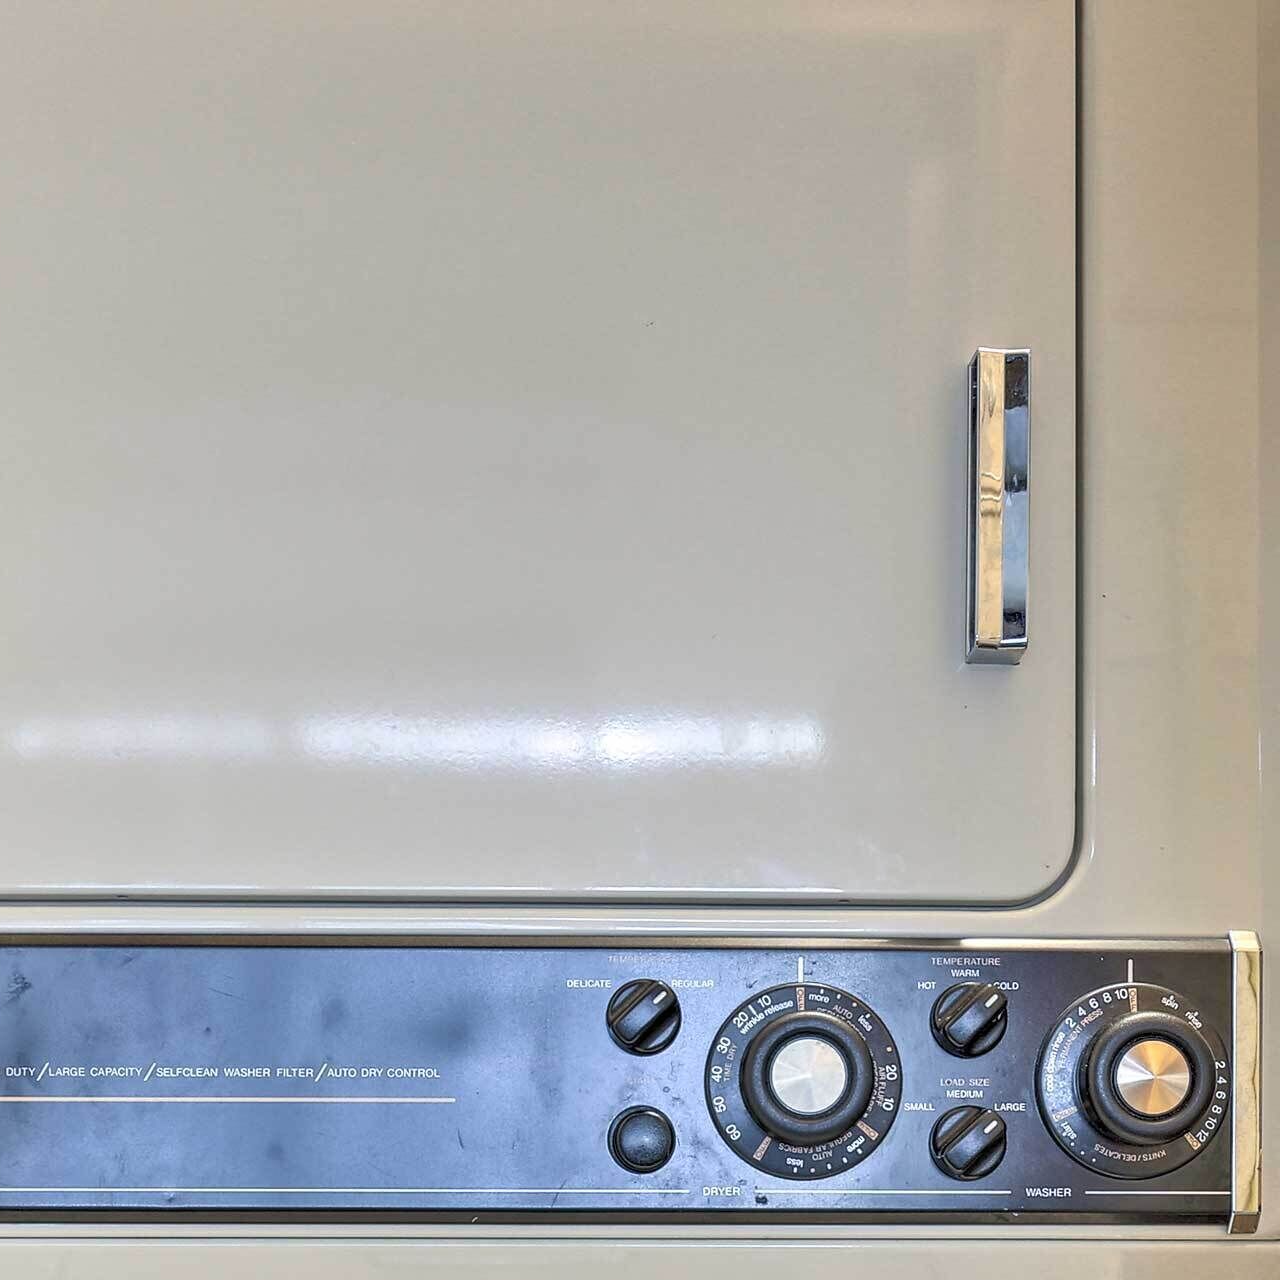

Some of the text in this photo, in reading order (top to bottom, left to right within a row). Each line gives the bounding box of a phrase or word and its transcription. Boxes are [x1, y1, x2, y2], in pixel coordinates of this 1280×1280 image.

[930, 957, 1001, 966] TEMPERATURE
[950, 969, 980, 977] WARM
[566, 979, 612, 988] DELICATE
[671, 979, 714, 988] REGULAR
[917, 981, 937, 990] HOT
[993, 981, 1019, 990] COLD
[757, 994, 771, 1008] 10
[808, 993, 830, 1003] more
[1161, 995, 1179, 1010] spin
[832, 1004, 853, 1019] AUTO
[1065, 988, 1128, 1028] 2 4 6 8 10
[733, 1011, 749, 1028] 20
[740, 1000, 793, 1035] wrinkle release
[857, 1014, 873, 1032] less
[1080, 1008, 1104, 1027] PRESS
[716, 1036, 731, 1054] 30
[723, 1043, 738, 1082] TIME DRY
[224, 1067, 271, 1077] WASHER
[361, 1067, 383, 1077] DRY
[386, 1067, 441, 1078] CONTROL
[711, 1065, 723, 1083] 40
[885, 1064, 898, 1081] 20
[876, 1066, 887, 1107] AIR FLUFF
[940, 1078, 990, 1087] LOAD SIZE
[946, 1089, 984, 1098] MEDIUM
[712, 1096, 727, 1113] 50
[882, 1097, 895, 1111] 10
[904, 1102, 936, 1112] SMALL
[993, 1102, 1026, 1112] LARGE
[1195, 1060, 1227, 1143] 2 4 6 8 10 12
[725, 1124, 741, 1141] 60
[778, 1142, 814, 1154] FABRICS
[846, 1135, 866, 1153] more
[786, 1157, 804, 1168] less
[812, 1150, 833, 1161] AUTO
[702, 1186, 741, 1196] DRYER
[1025, 1187, 1072, 1198] WASHER
